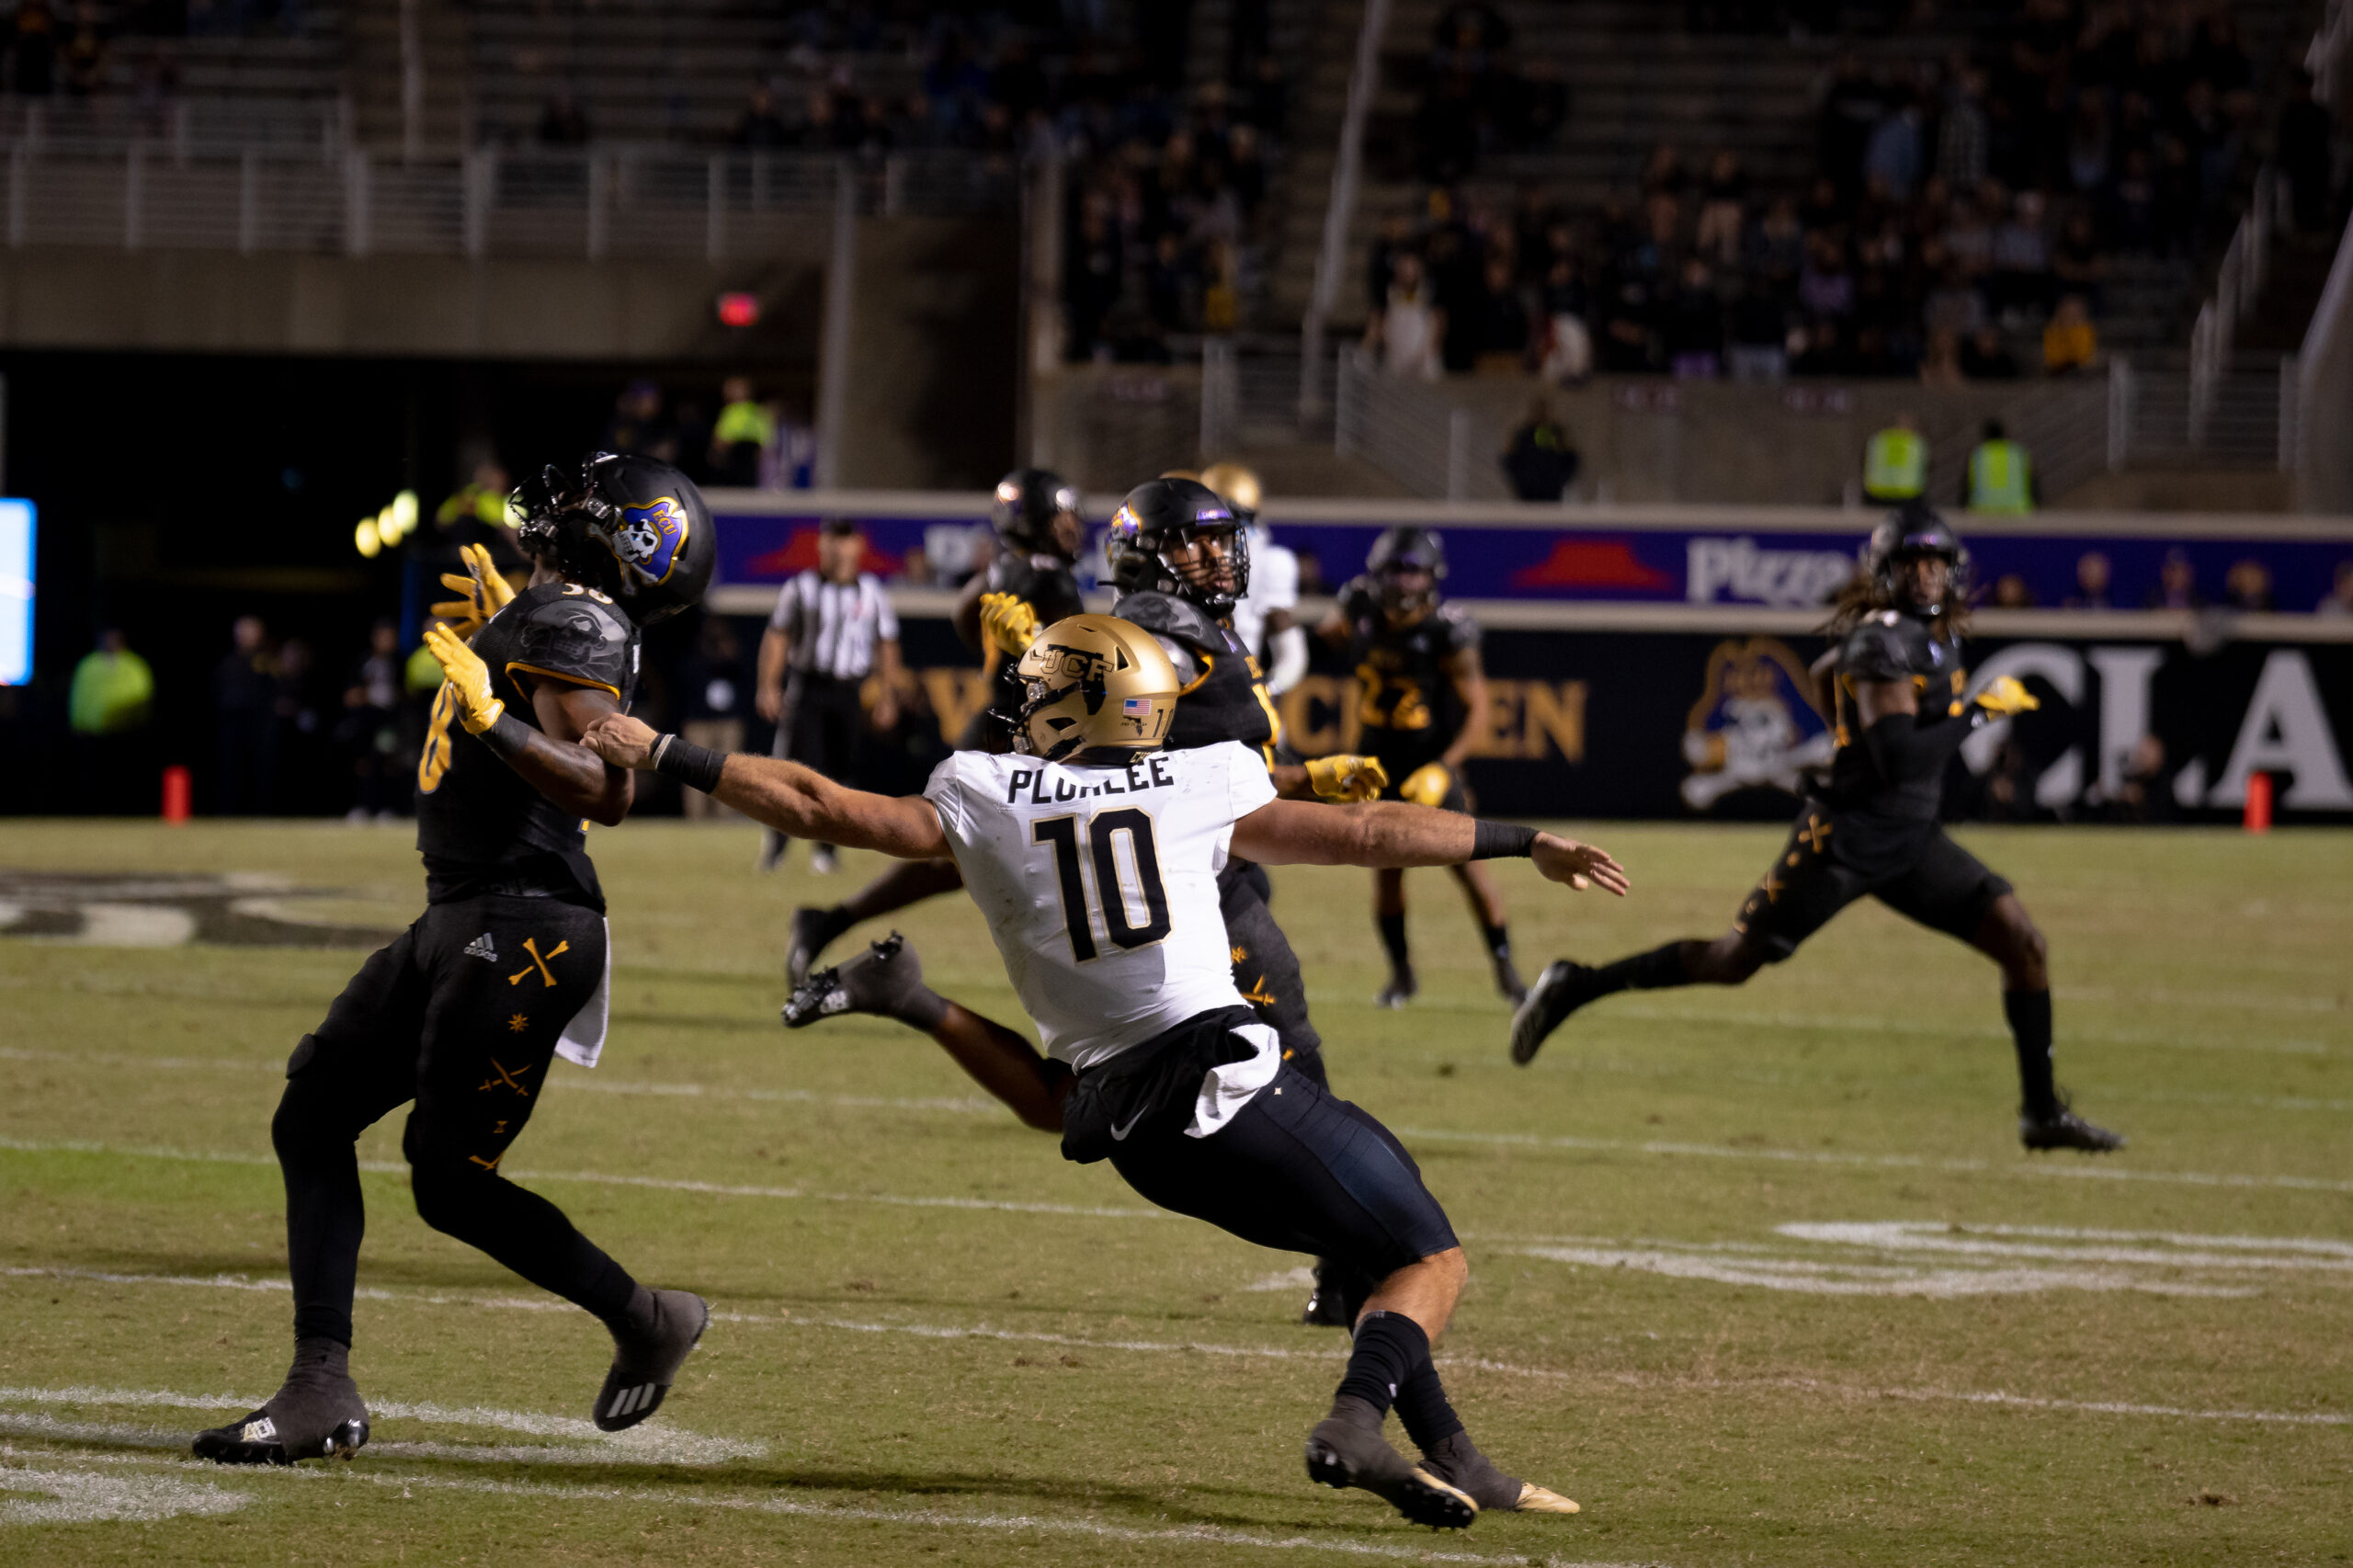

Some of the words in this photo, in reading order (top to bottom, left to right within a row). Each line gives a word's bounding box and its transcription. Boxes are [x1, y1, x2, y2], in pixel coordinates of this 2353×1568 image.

[652, 509, 677, 535] ECU
[1030, 648, 1114, 683] UCF
[1029, 804, 1175, 963] 10
